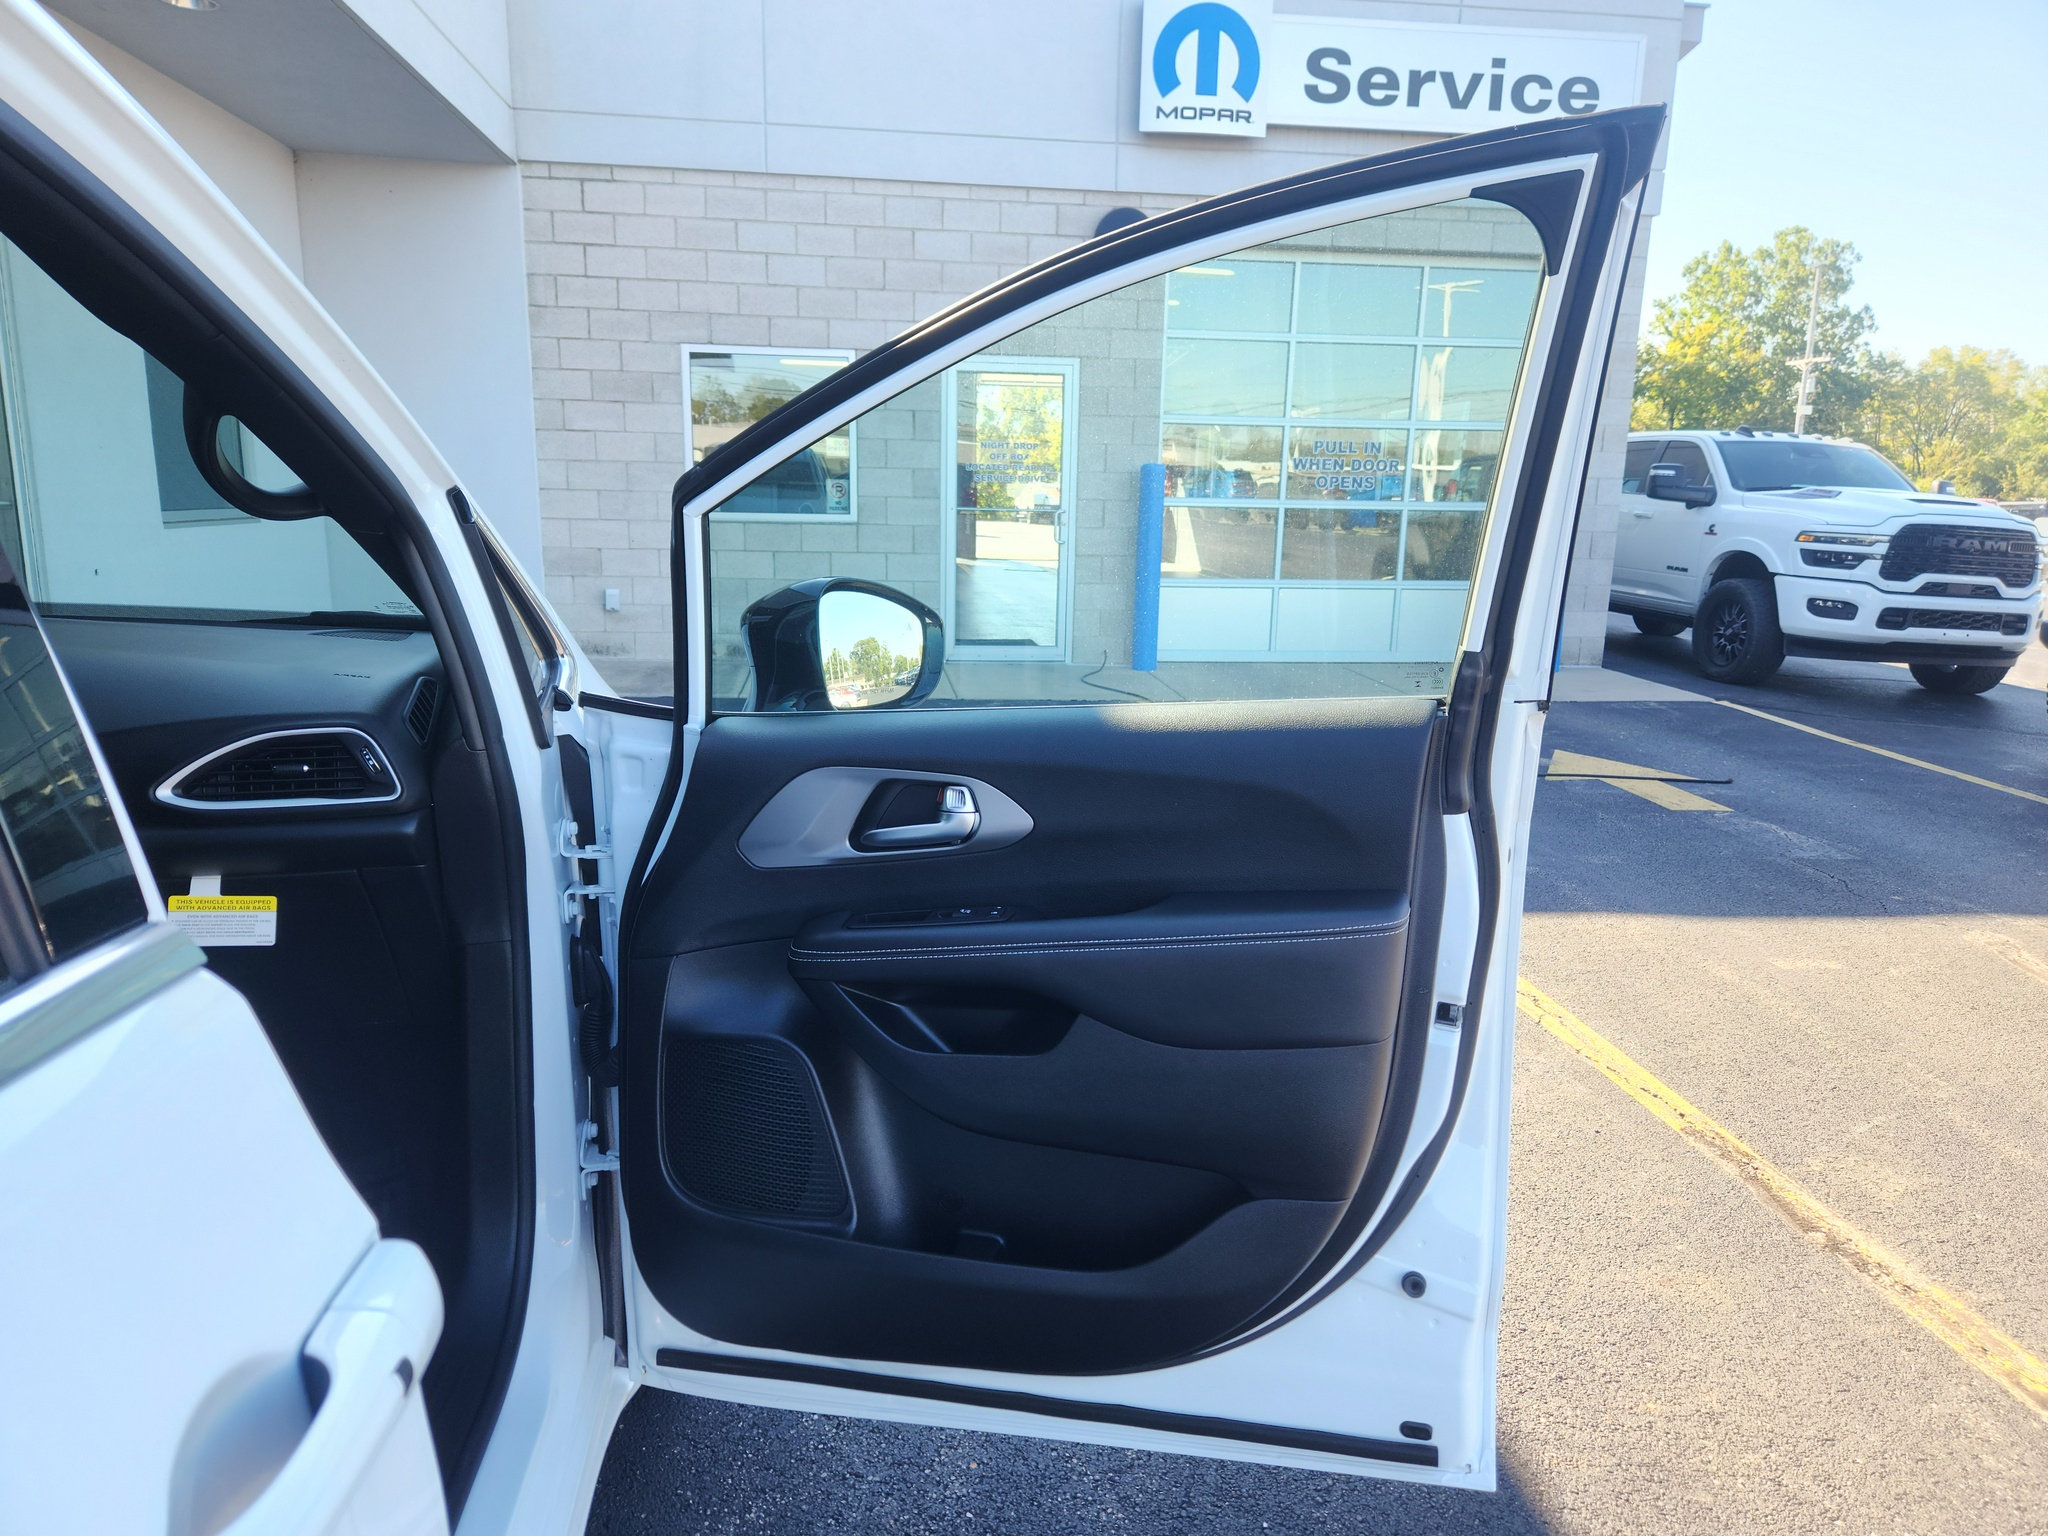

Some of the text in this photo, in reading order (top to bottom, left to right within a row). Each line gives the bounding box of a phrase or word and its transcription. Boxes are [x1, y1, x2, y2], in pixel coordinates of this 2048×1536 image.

[1304, 46, 1600, 116] Service
[1156, 105, 1252, 124] MOPAR
[980, 441, 1039, 450] NIGHT DROP
[1313, 440, 1382, 454] PULL IN
[1292, 457, 1400, 472] WHEN DOOR
[974, 473, 1047, 483] SERVICE DRIVE
[1315, 475, 1376, 489] OPENS
[1932, 536, 2008, 552] RAM
